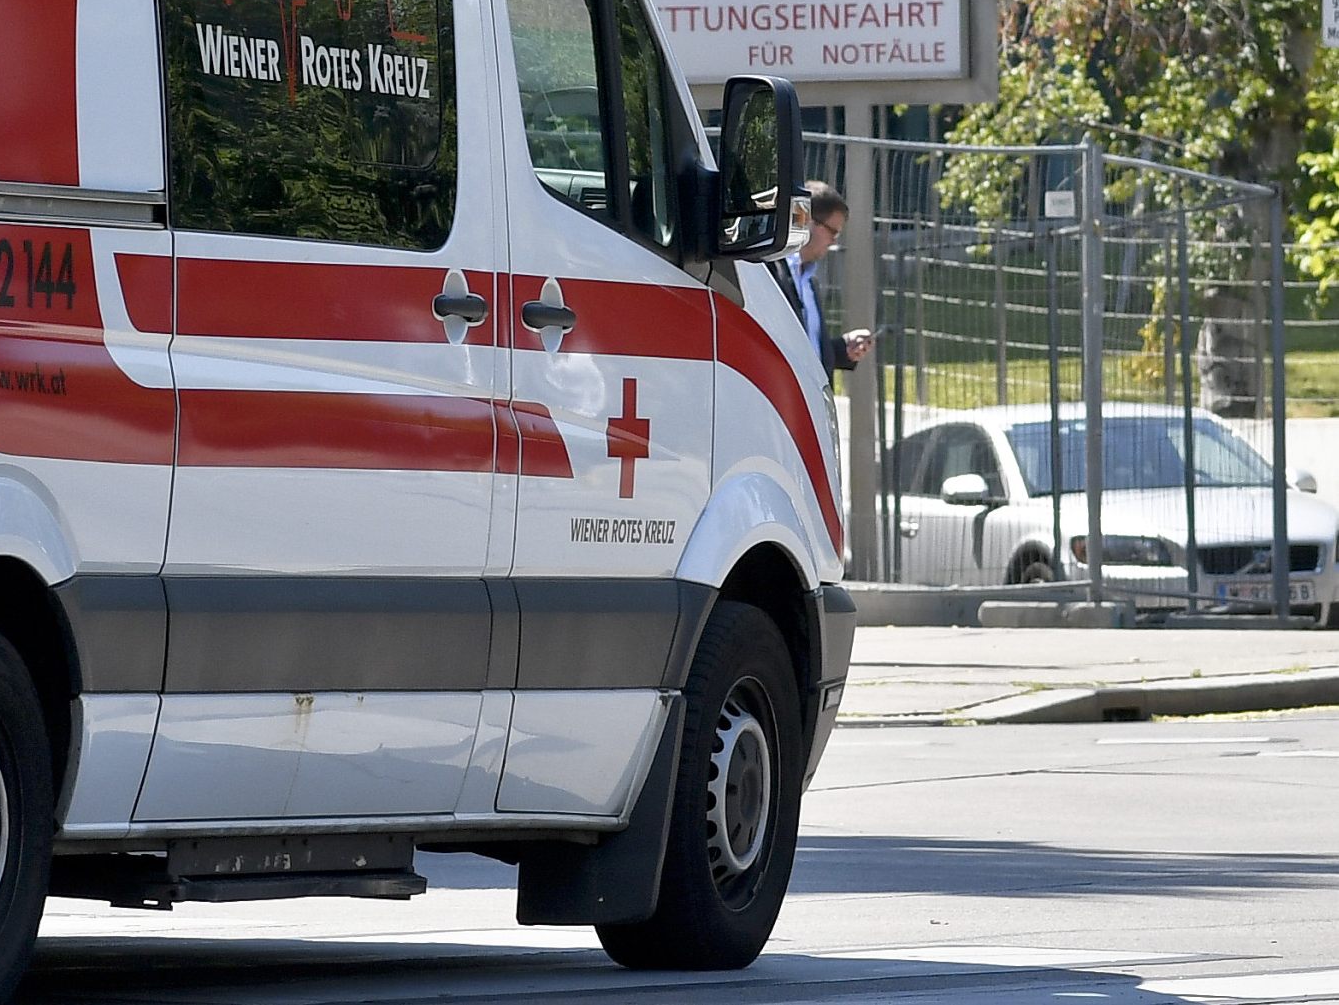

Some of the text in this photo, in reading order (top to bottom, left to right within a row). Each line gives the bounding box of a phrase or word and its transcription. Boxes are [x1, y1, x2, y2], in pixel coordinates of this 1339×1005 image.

[658, 1, 944, 33] TTUNGSEINFAHRT
[195, 23, 430, 99] WIENER ROTES KREUZ
[748, 39, 946, 67] FÜR NOTFÄLLE
[23, 239, 76, 310] 144
[570, 518, 677, 545] WIENER ROTES KREUZ
